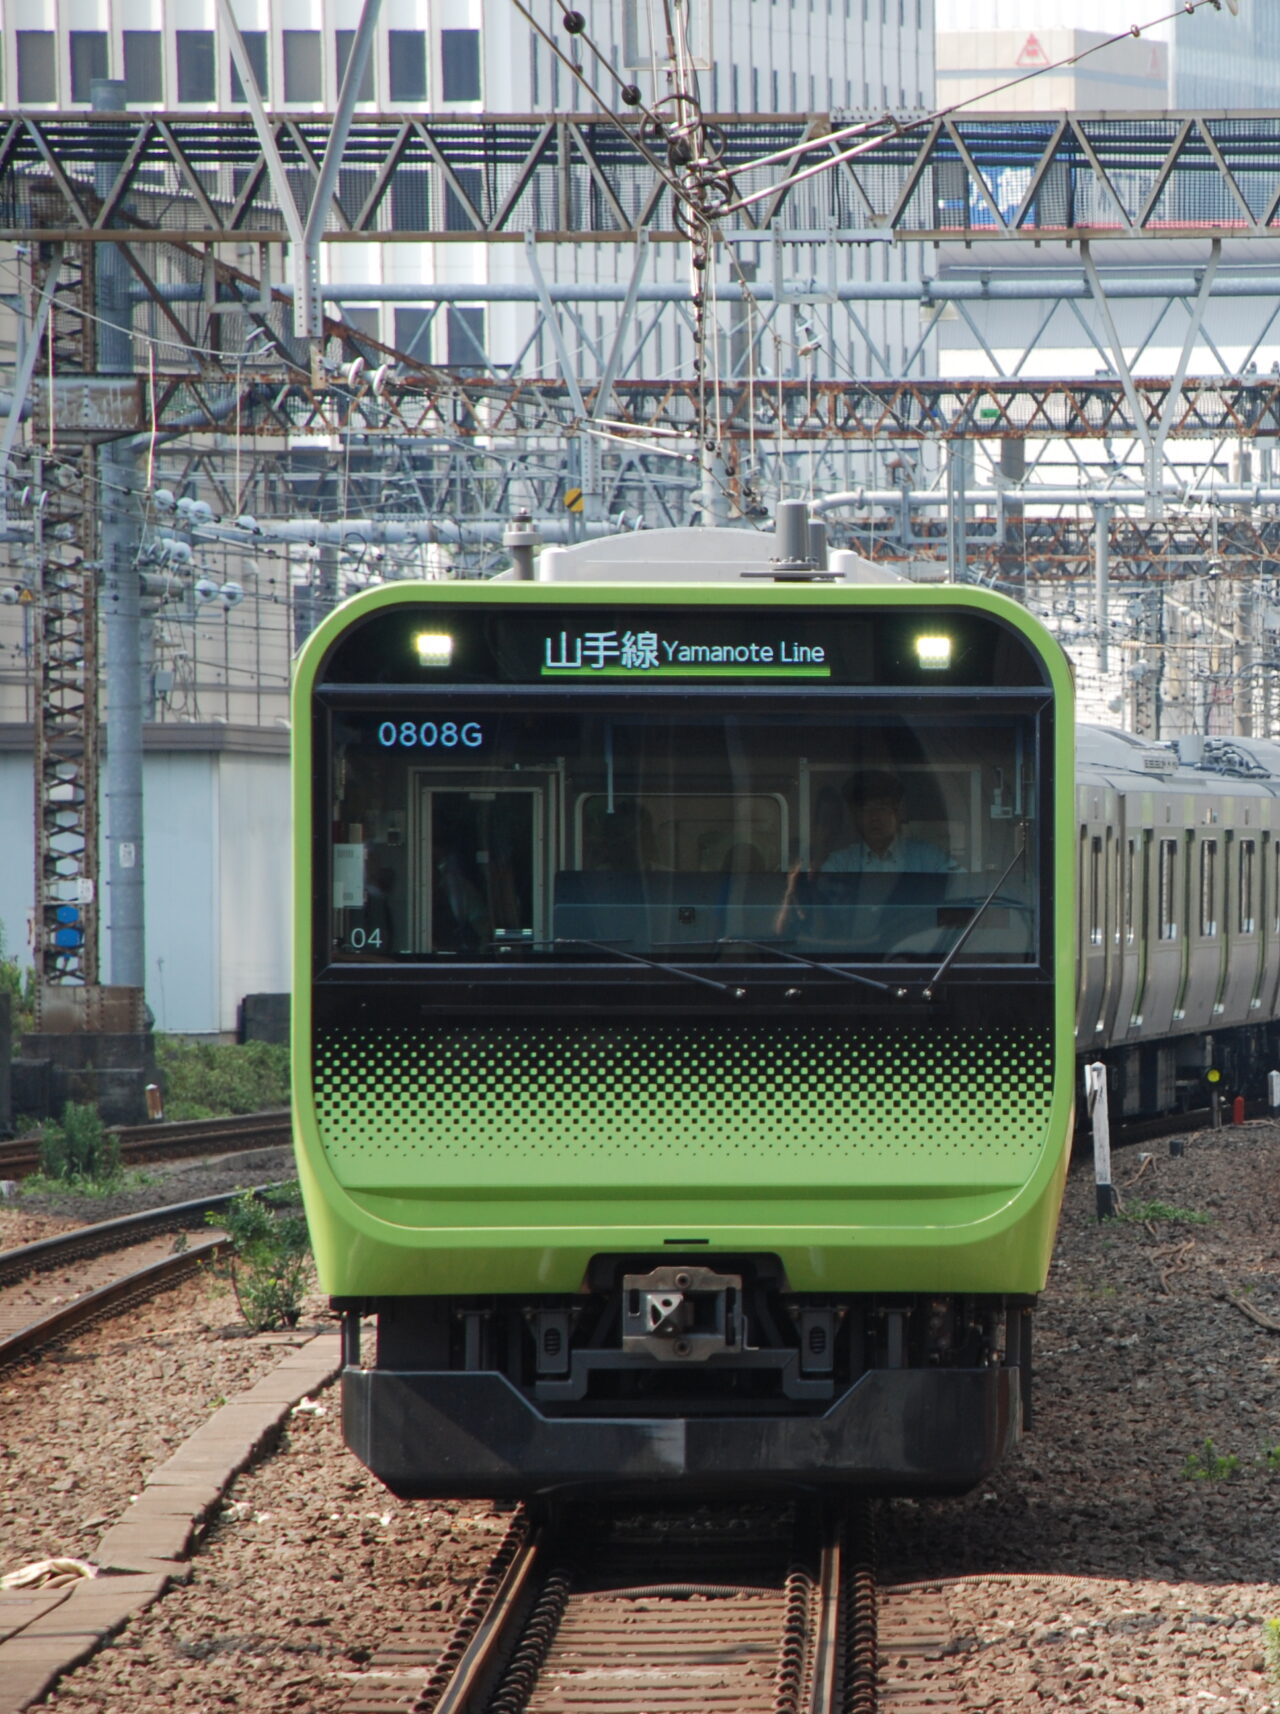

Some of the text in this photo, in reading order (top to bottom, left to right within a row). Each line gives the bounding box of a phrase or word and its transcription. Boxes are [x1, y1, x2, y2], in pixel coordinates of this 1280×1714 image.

[545, 631, 825, 669] 山手線 Yamanote Line
[378, 721, 483, 747] 0808G
[351, 927, 383, 949] 04
